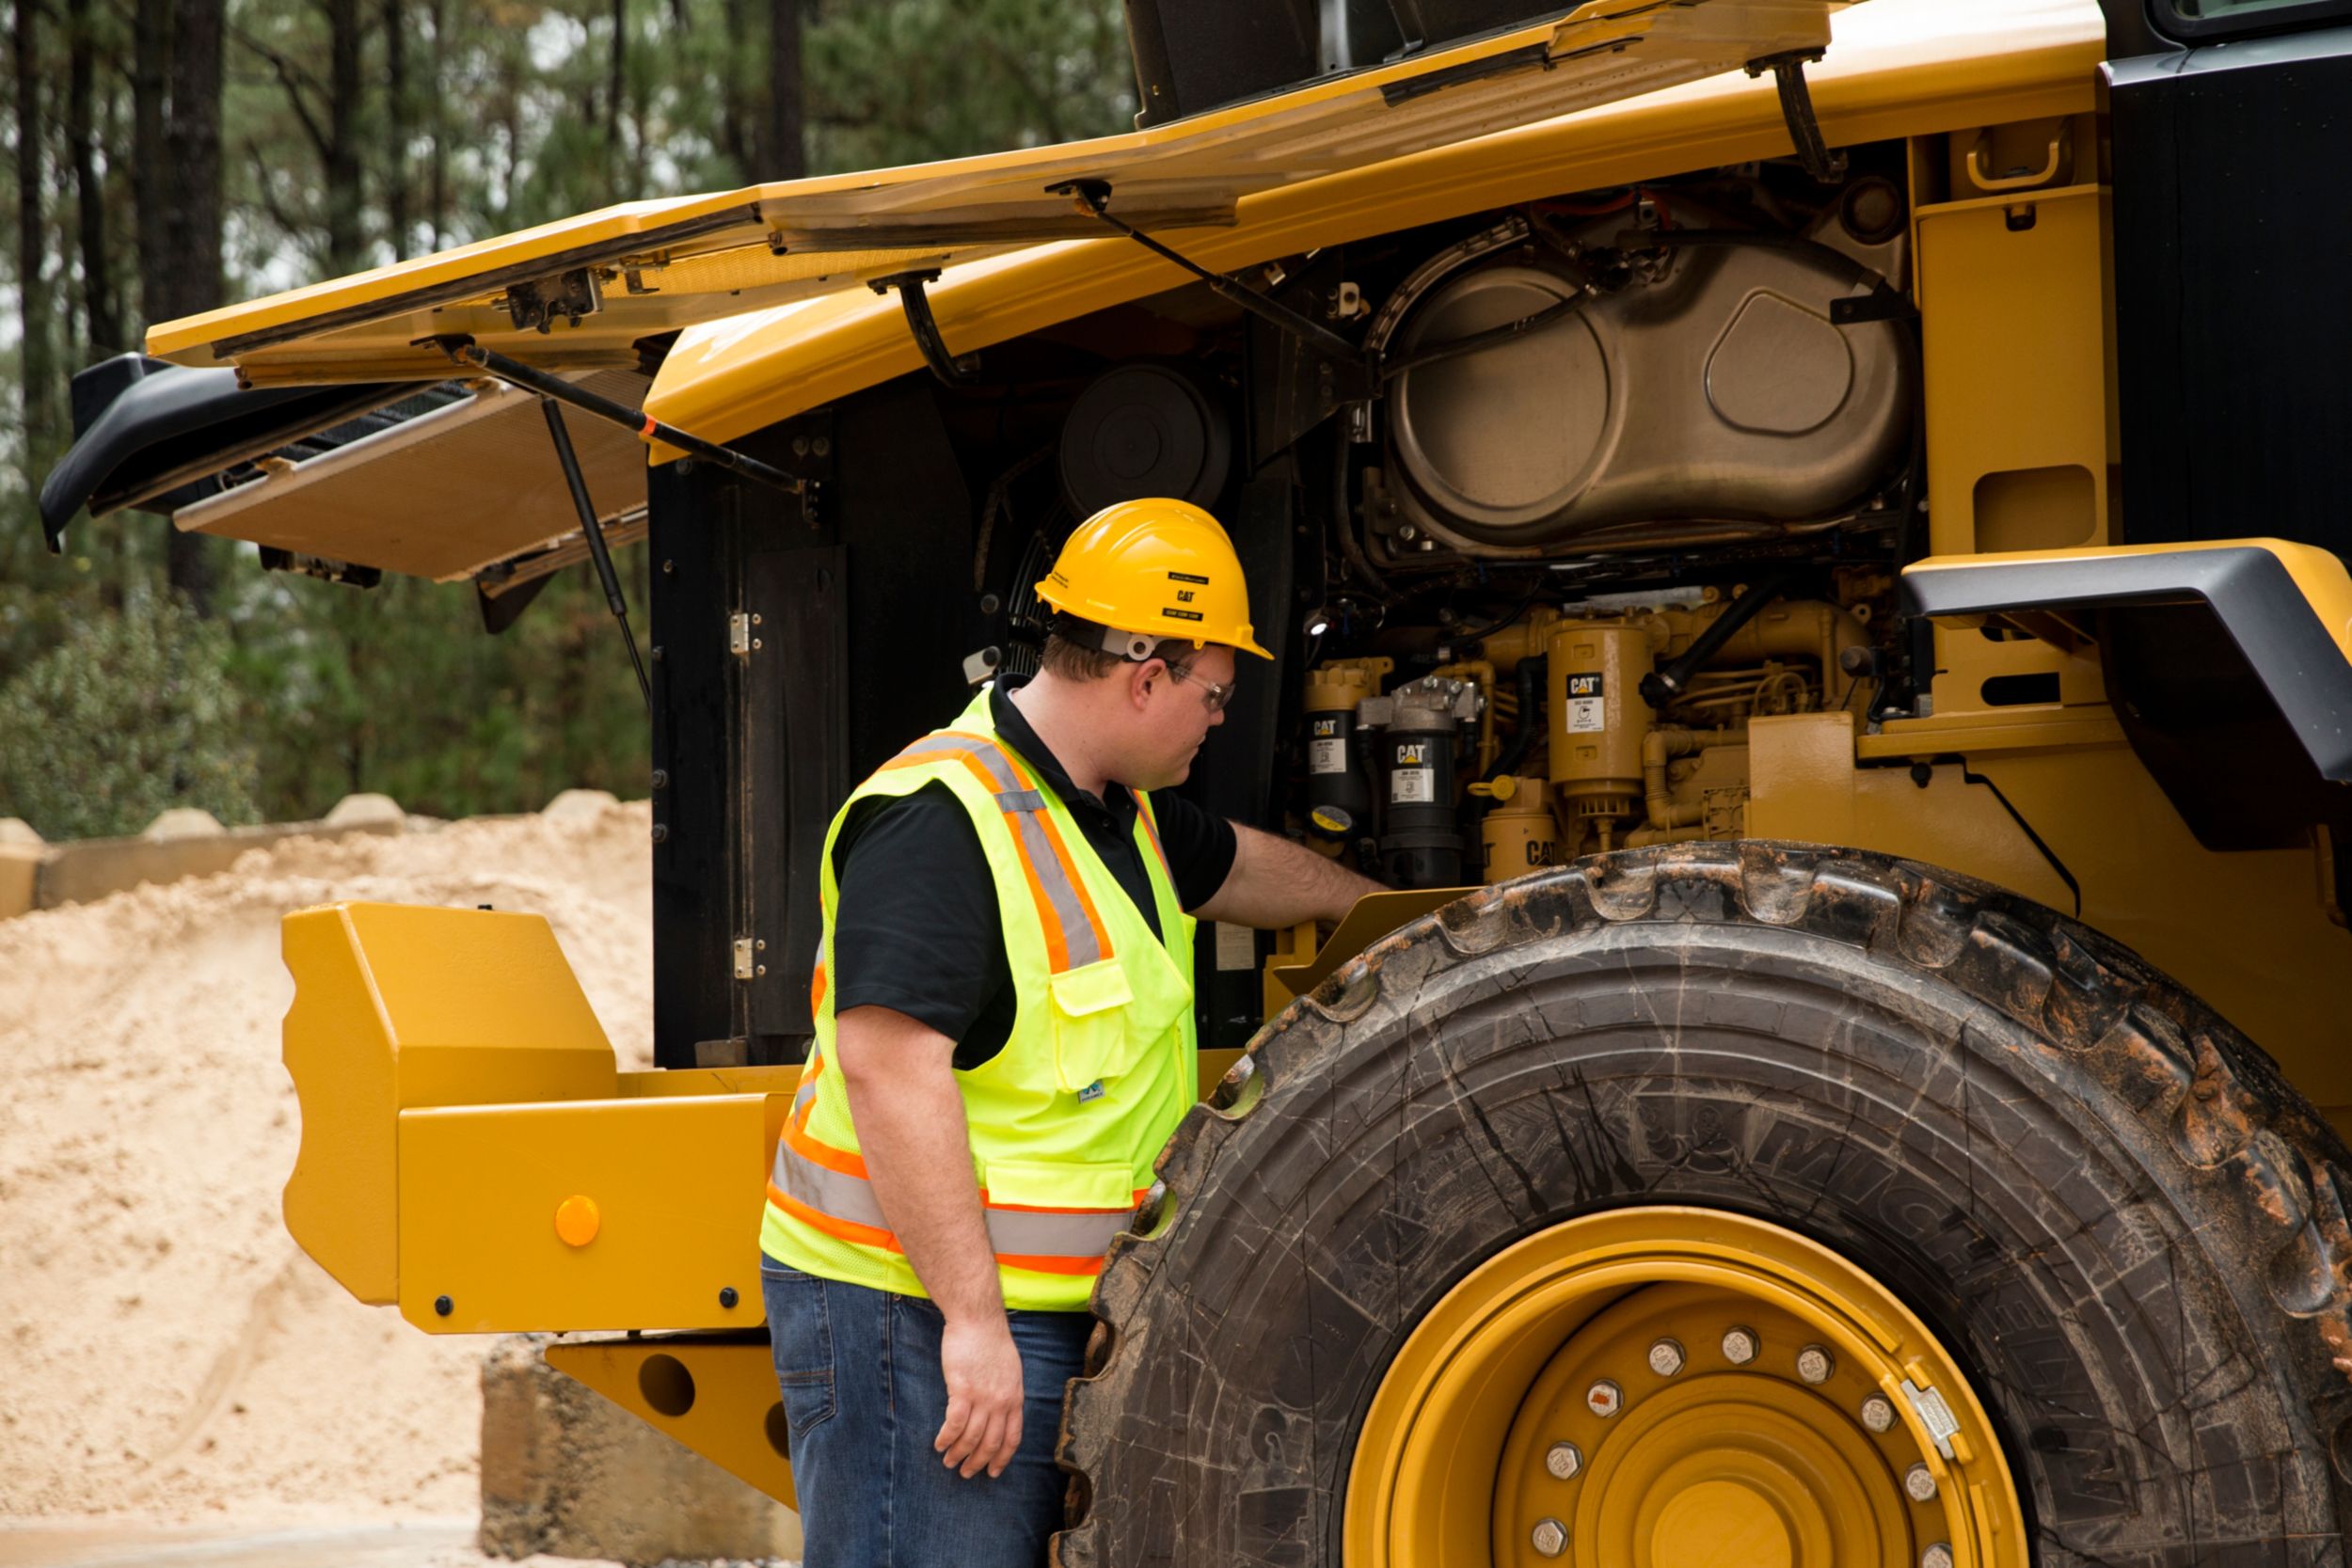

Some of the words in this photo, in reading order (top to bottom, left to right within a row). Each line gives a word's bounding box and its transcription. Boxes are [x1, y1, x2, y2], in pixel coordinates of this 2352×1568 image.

[1177, 590, 1195, 602] CAT
[1570, 677, 1595, 694] CAT
[1314, 721, 1336, 736] CAT
[1397, 744, 1425, 764] CAT
